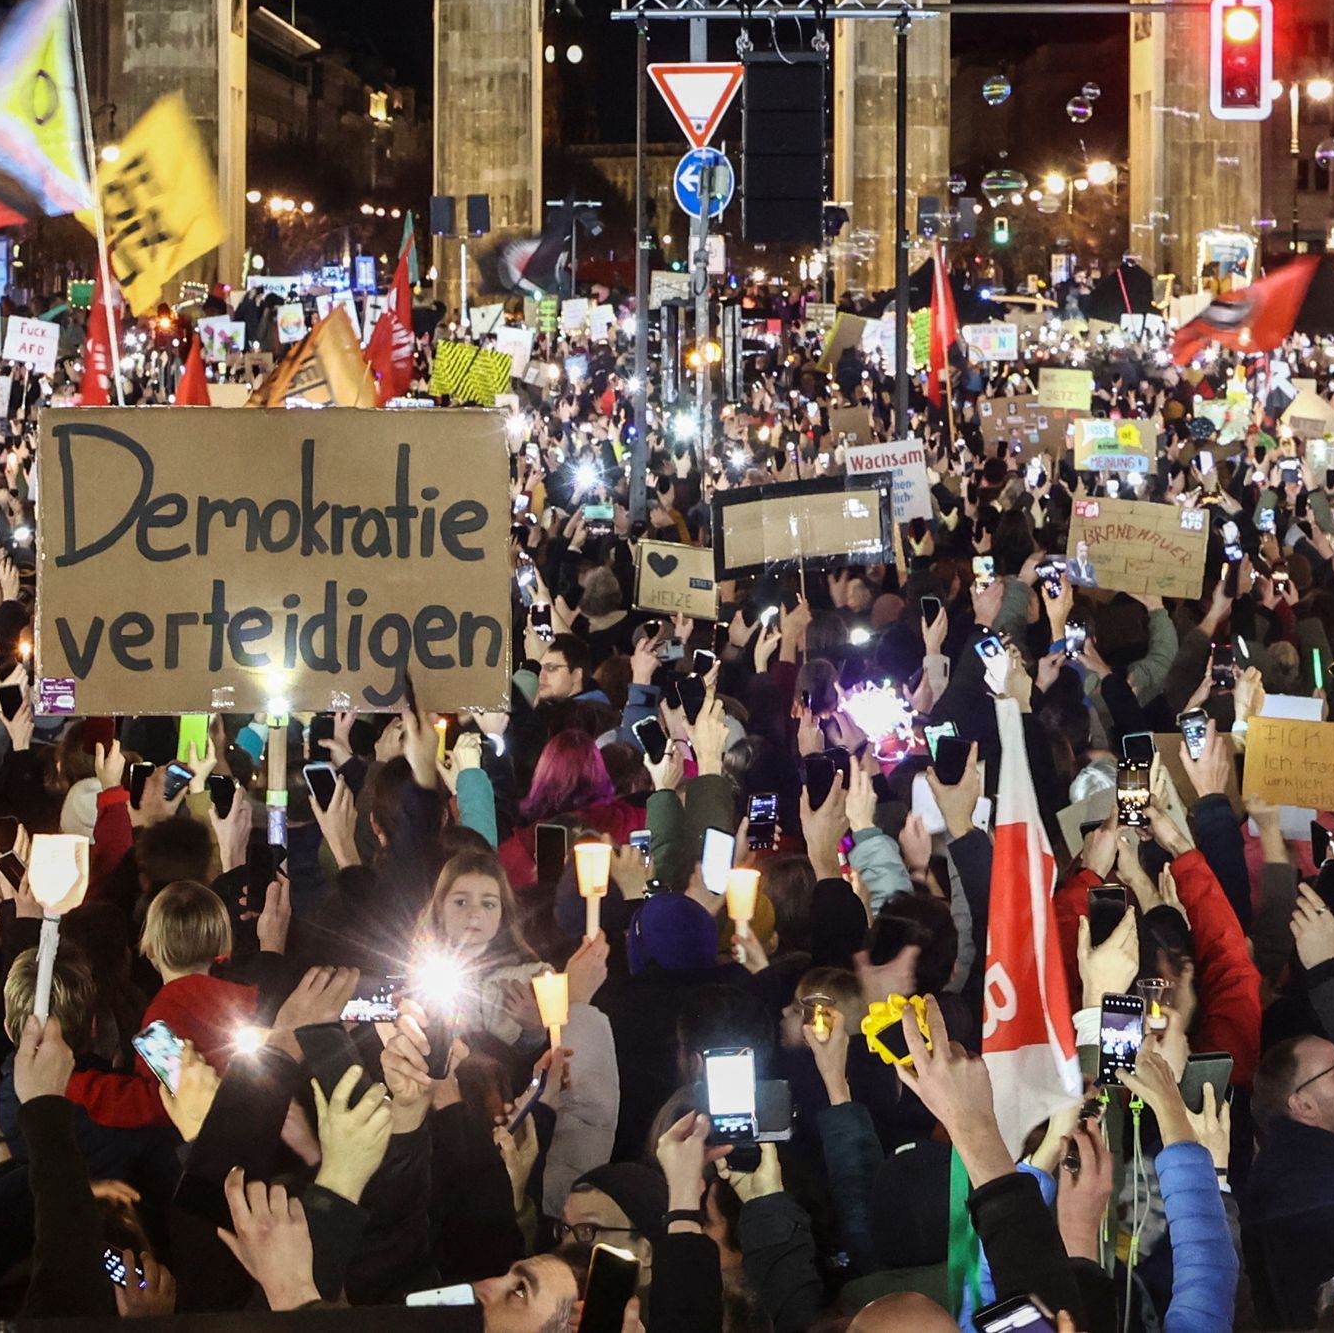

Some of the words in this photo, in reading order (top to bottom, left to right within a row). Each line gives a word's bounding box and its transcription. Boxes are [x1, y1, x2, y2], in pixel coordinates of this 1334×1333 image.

[19, 342, 44, 355] AFD
[849, 449, 924, 473] Wachsam
[52, 423, 489, 567] Demokratie
[1083, 524, 1192, 564] BRANDMAUER
[651, 590, 692, 609] HETZE
[55, 579, 503, 707] verteidigen
[1262, 724, 1322, 748] FICK
